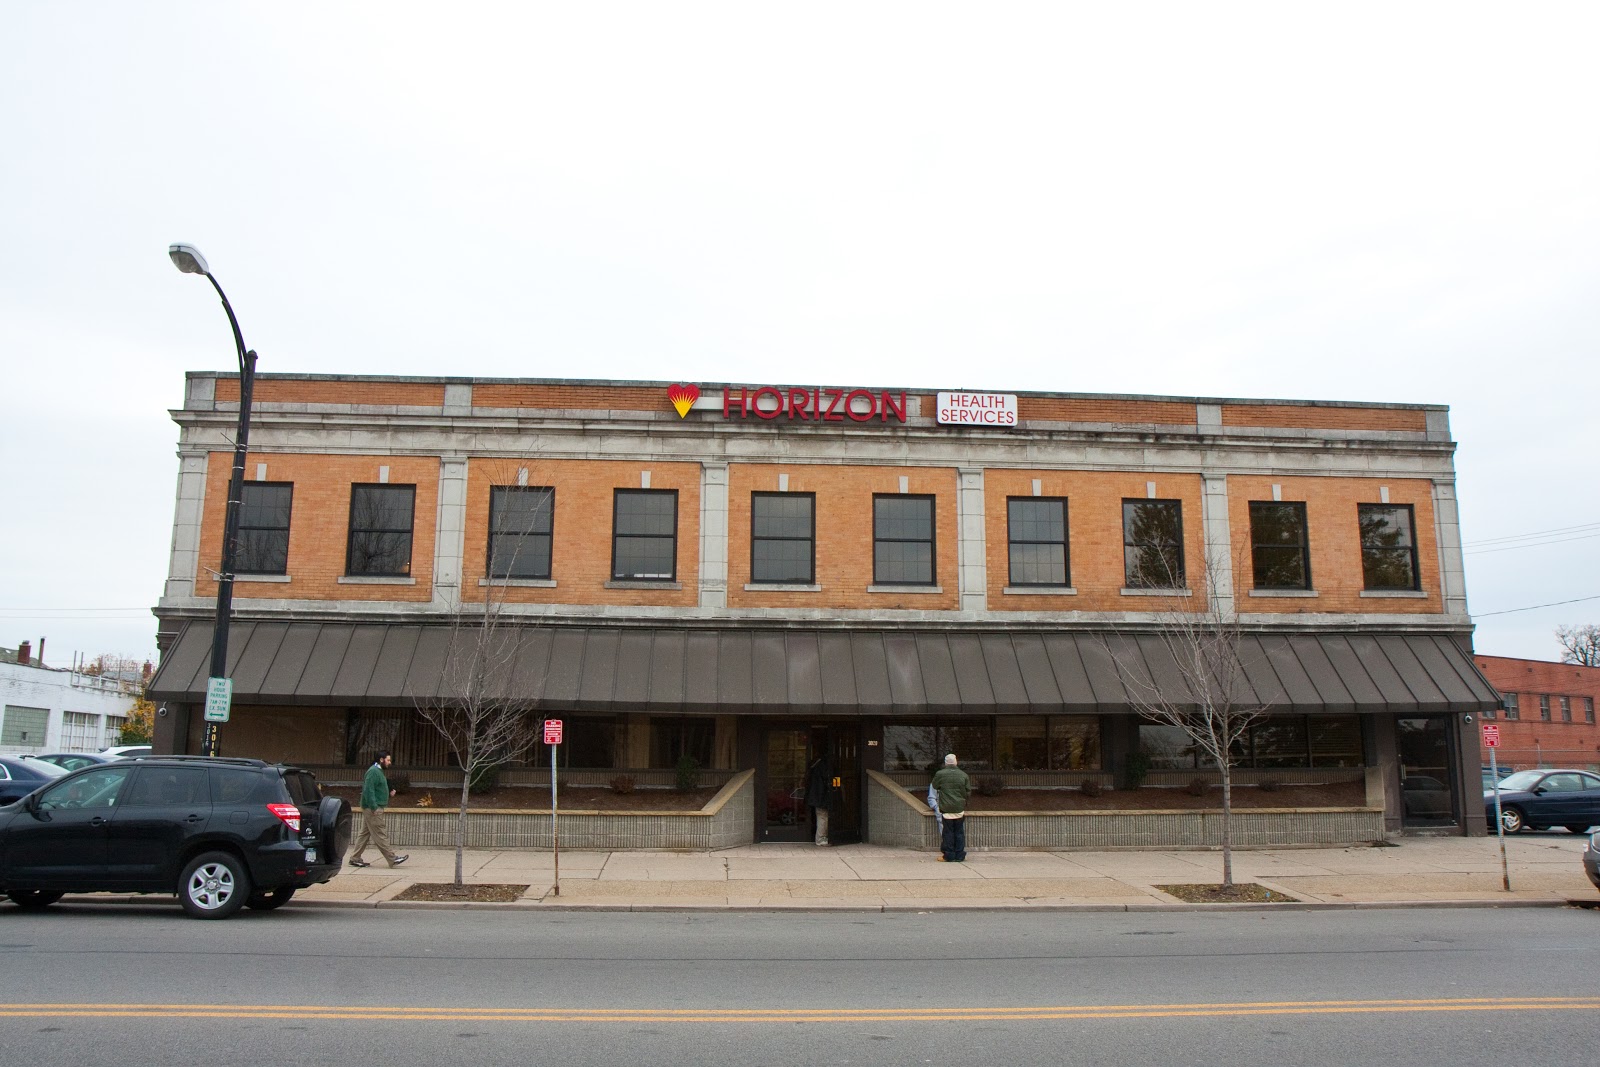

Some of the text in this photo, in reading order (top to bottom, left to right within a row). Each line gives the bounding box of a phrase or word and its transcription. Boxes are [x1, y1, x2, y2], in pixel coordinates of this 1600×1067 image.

[724, 387, 907, 423] HORIZON
[949, 394, 1005, 409] HEALTH
[941, 408, 1014, 425] SERVICES
